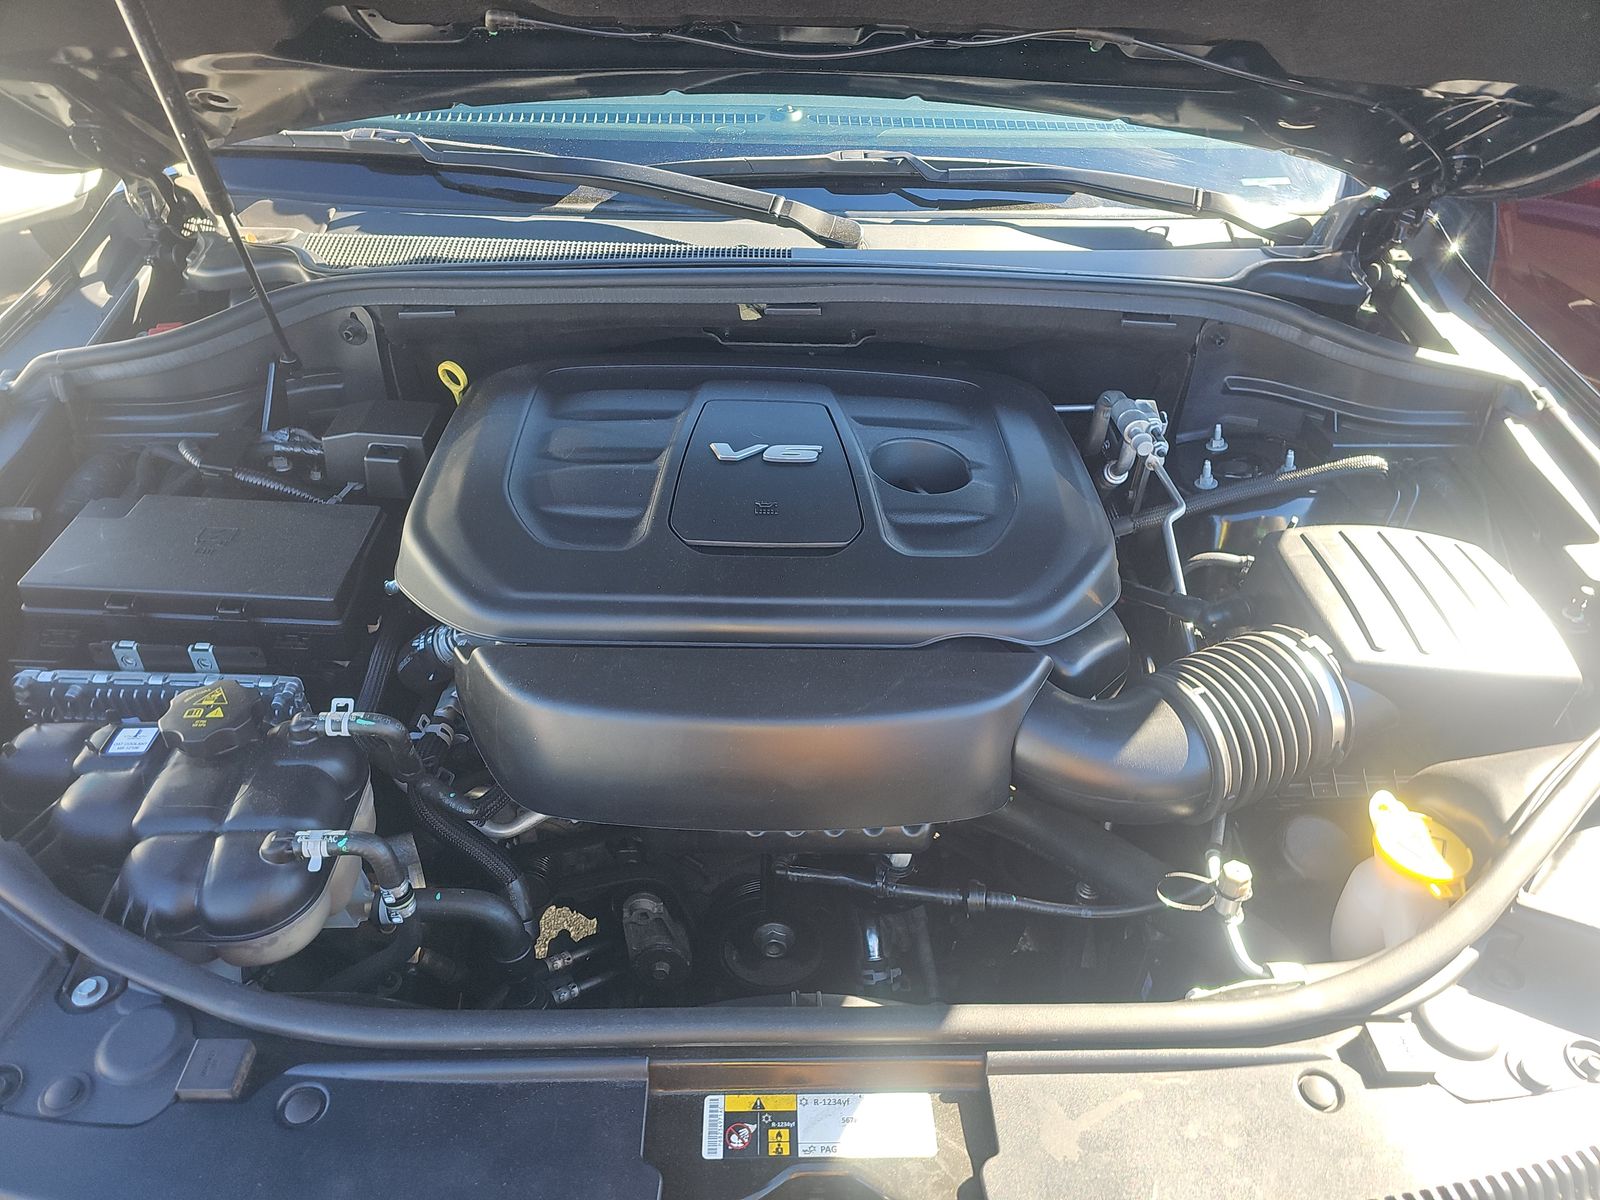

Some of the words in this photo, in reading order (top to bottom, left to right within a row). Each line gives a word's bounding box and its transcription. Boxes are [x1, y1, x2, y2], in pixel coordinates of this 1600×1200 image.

[709, 442, 823, 464] V6
[813, 1097, 851, 1107] R-1234yf
[820, 1145, 838, 1154] PAG
